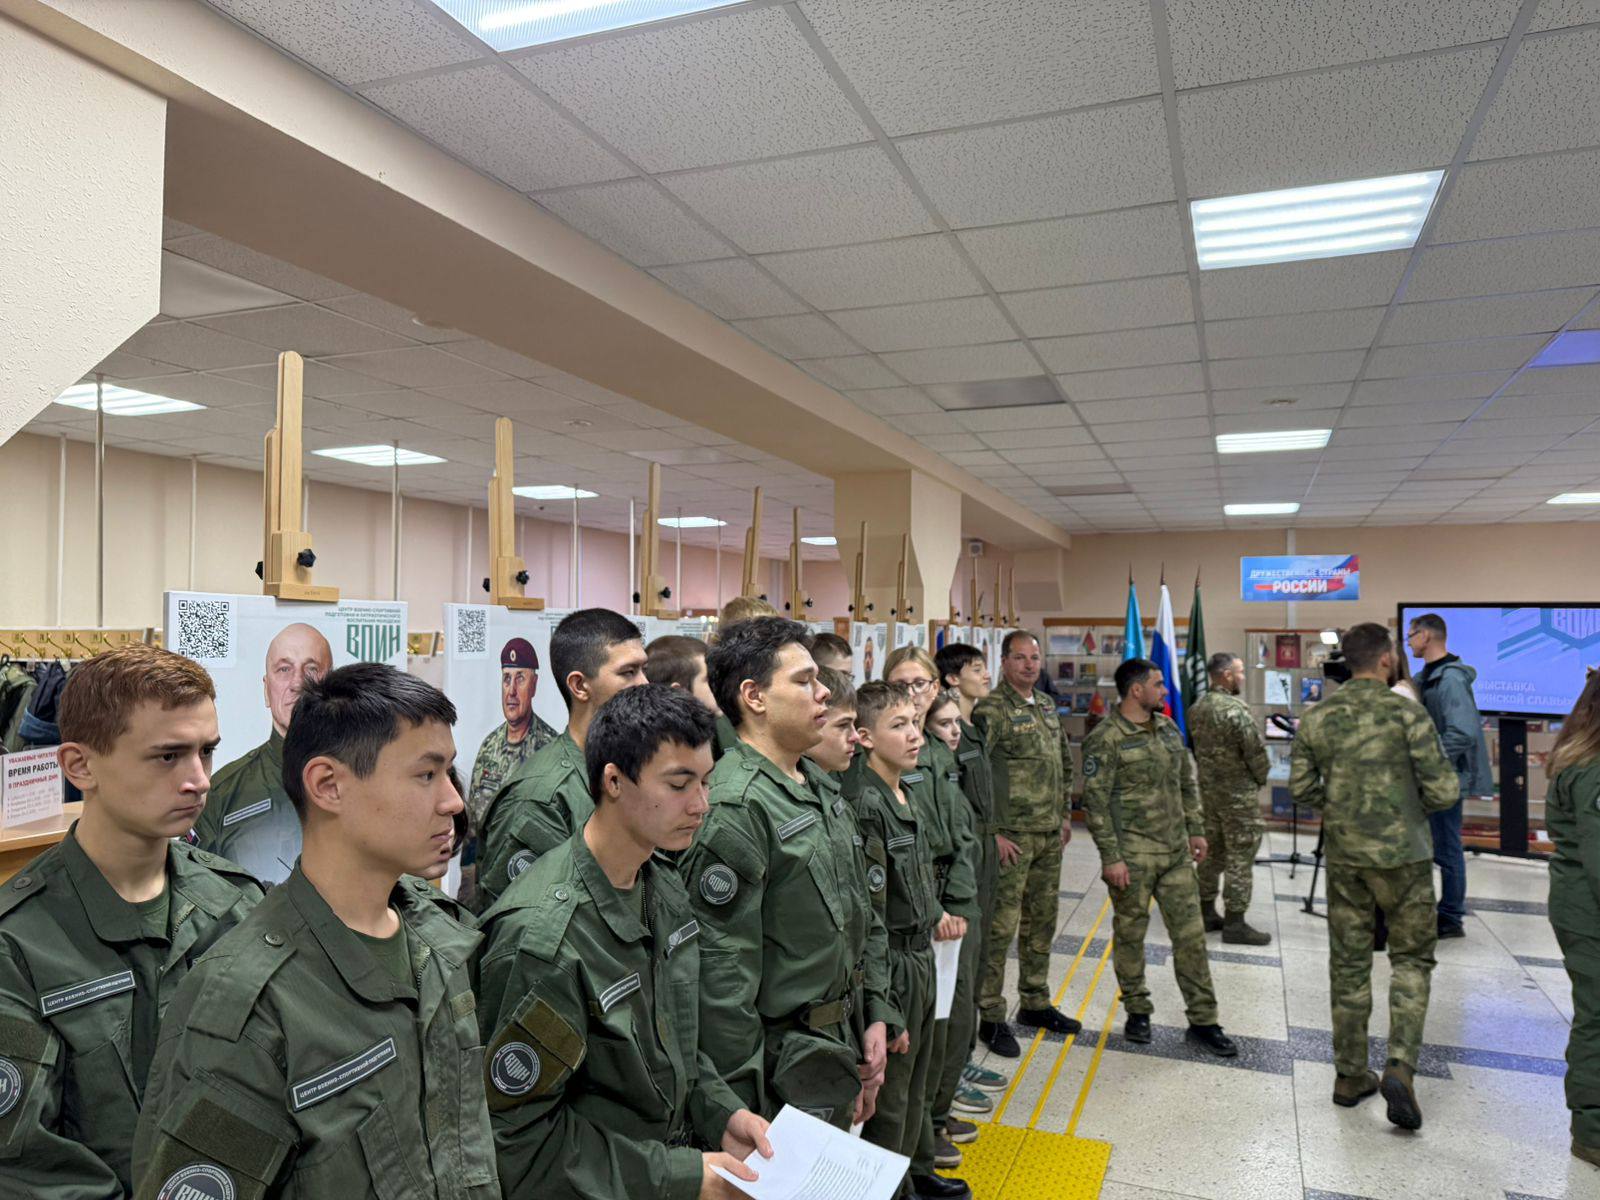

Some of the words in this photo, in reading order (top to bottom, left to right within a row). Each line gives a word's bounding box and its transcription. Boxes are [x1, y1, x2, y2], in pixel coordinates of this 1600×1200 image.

[1272, 579, 1328, 593] РОССИИ
[346, 624, 401, 663] ВПИН
[8, 765, 31, 777] ВРЕМЯ
[300, 1086, 317, 1098] ЦЕНТР
